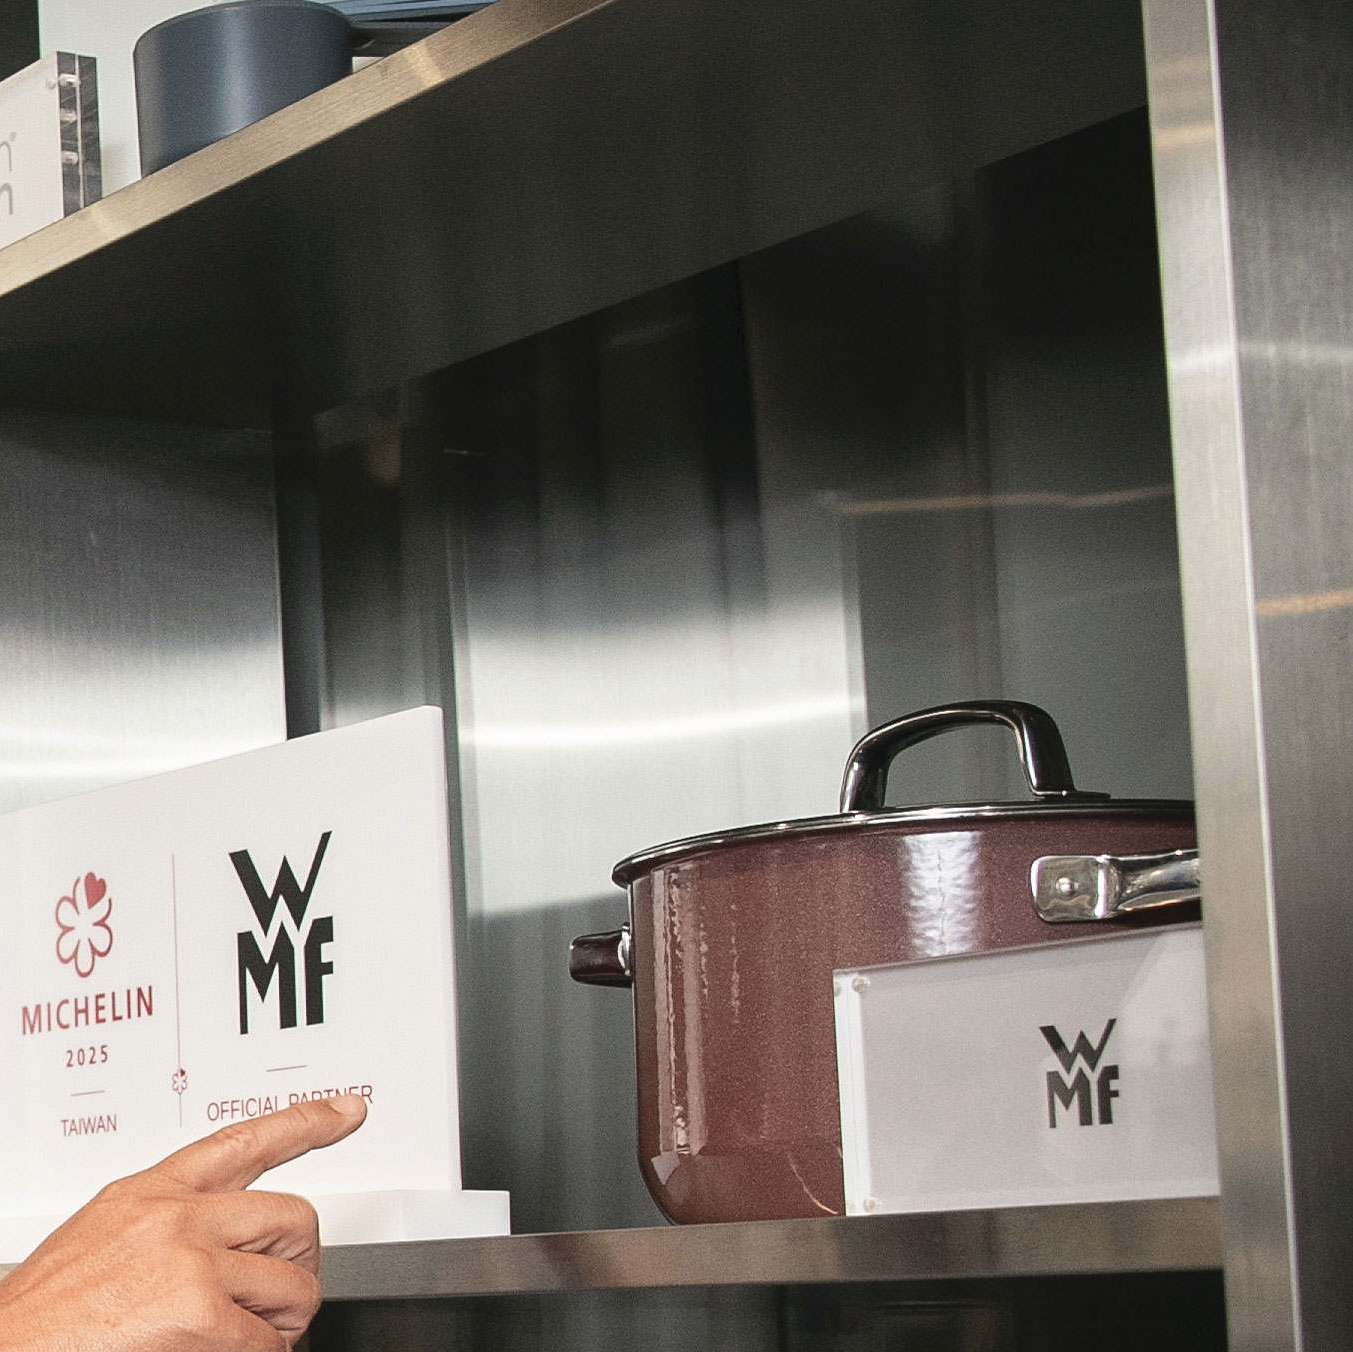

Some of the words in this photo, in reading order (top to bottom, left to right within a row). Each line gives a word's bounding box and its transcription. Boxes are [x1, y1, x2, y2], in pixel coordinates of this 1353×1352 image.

[21, 985, 154, 1035] MICHELIN
[66, 1044, 108, 1068] 2025
[207, 1095, 279, 1121] OFFICIAL
[60, 1113, 117, 1137] TAIWAN
